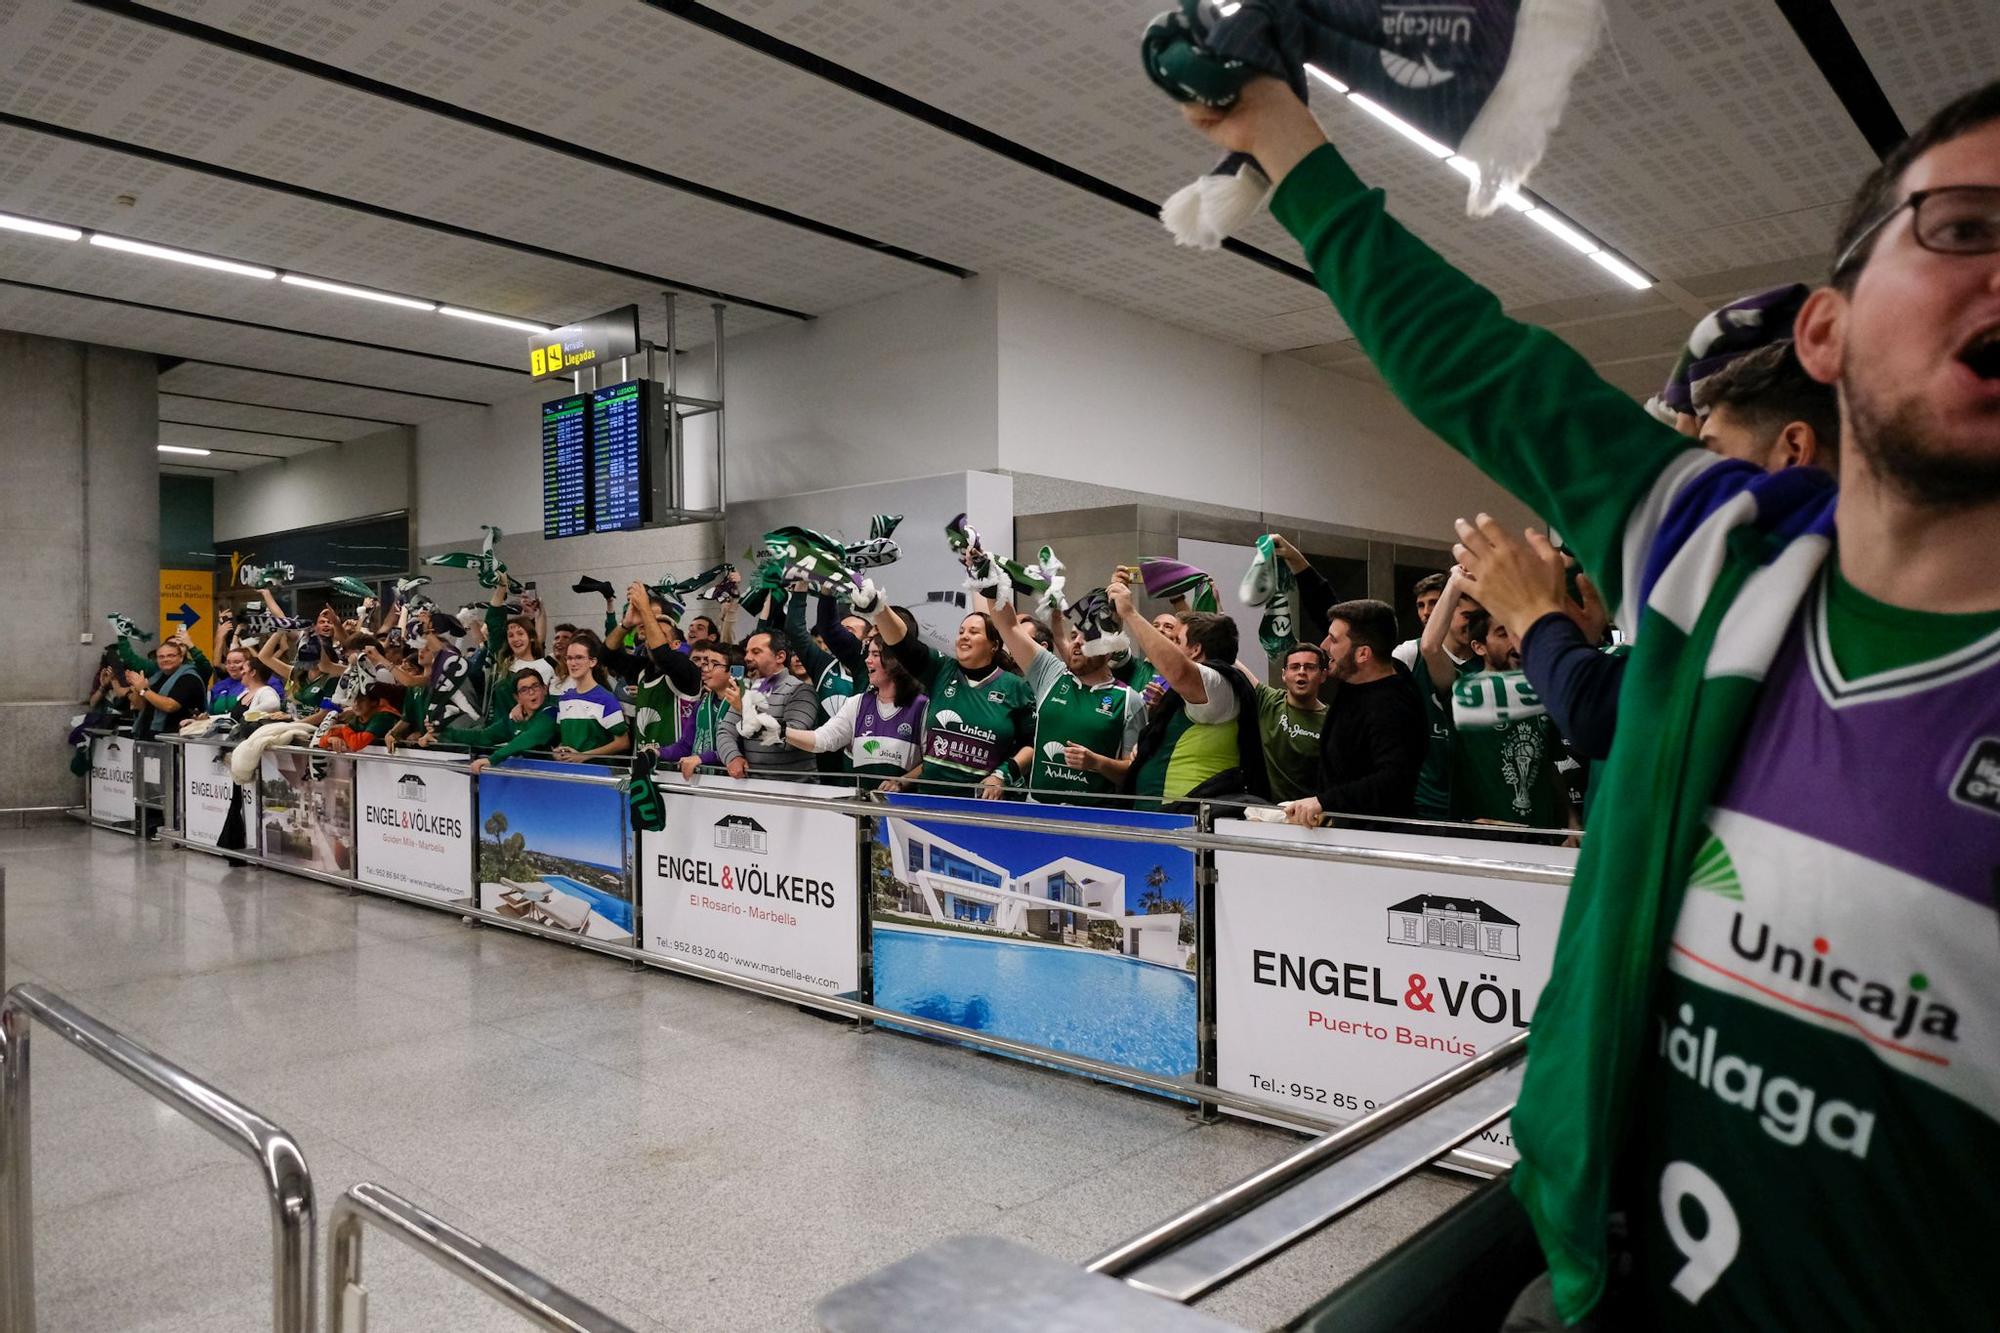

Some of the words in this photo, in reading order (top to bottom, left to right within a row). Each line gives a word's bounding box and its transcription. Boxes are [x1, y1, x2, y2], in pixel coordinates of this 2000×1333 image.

[1382, 11, 1472, 46] Unicaja
[564, 350, 596, 366] Llegadas
[959, 723, 997, 741] Unicaja
[657, 854, 836, 909] ENGEL&VÖLKERS
[690, 894, 700, 906] El
[702, 897, 741, 915] Rosario
[749, 906, 797, 926] Marbella
[673, 941, 690, 954] 952
[691, 945, 703, 957] 83
[704, 948, 716, 960] 20
[717, 952, 729, 963] 40
[1253, 949, 1530, 1028] ENGEL&VÖL
[1730, 911, 1960, 1043] Unicaja
[1307, 1010, 1388, 1040] Puerto
[1395, 1026, 1477, 1058] Banús
[1250, 1074, 1285, 1095] Tel.:
[1290, 1083, 1328, 1104] 952
[1332, 1093, 1358, 1111] 85
[1658, 1002, 1875, 1160] álaga
[1659, 1160, 1740, 1305] 9
